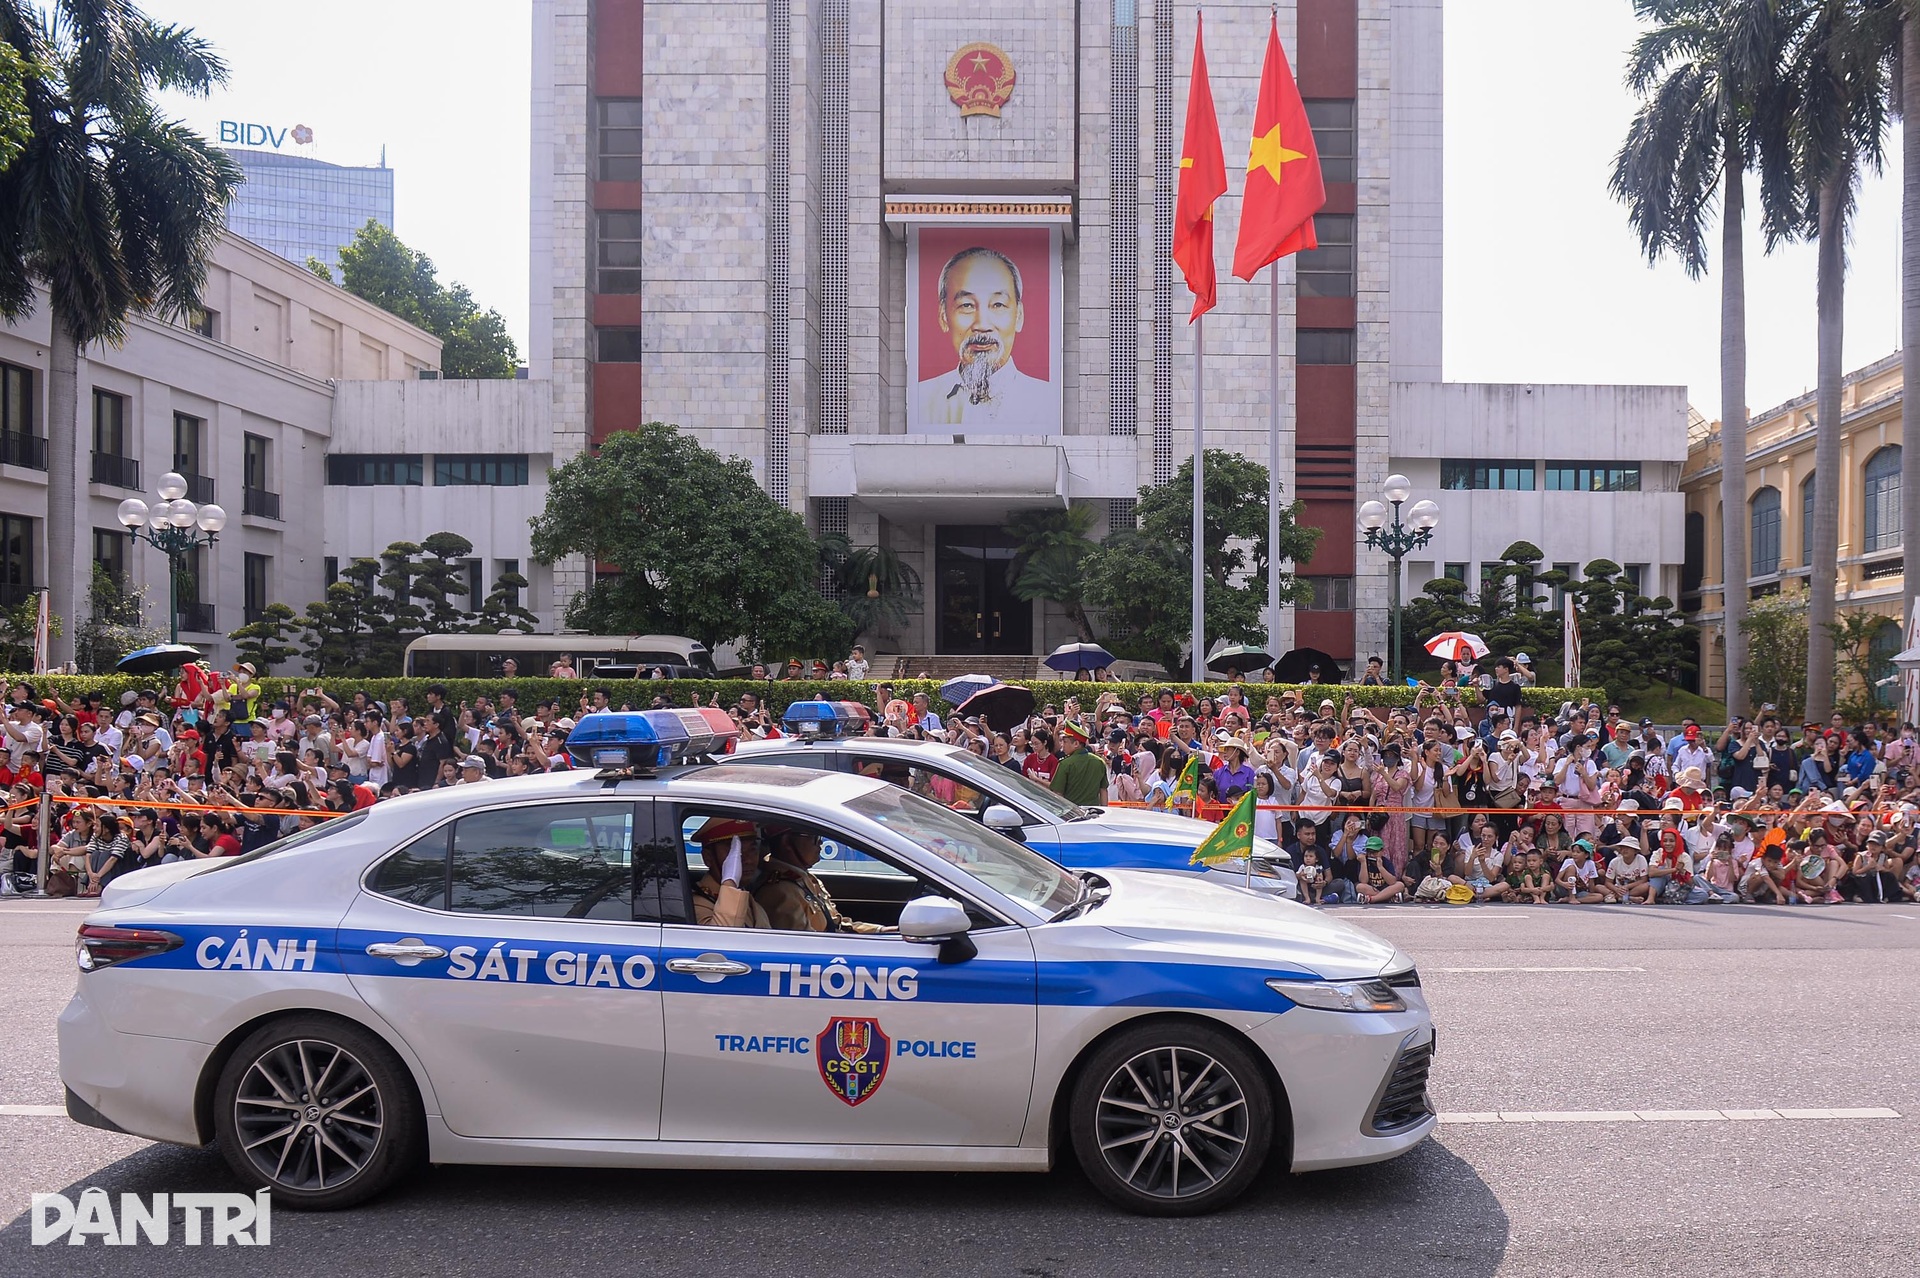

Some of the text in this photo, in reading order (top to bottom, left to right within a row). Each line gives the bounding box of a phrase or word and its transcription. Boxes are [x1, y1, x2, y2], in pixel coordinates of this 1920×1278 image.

[220, 120, 288, 149] BIDV
[196, 929, 919, 1000] CẢNH SÁT GIAO THÔNG
[715, 1034, 977, 1059] TRAFFIC POLICE
